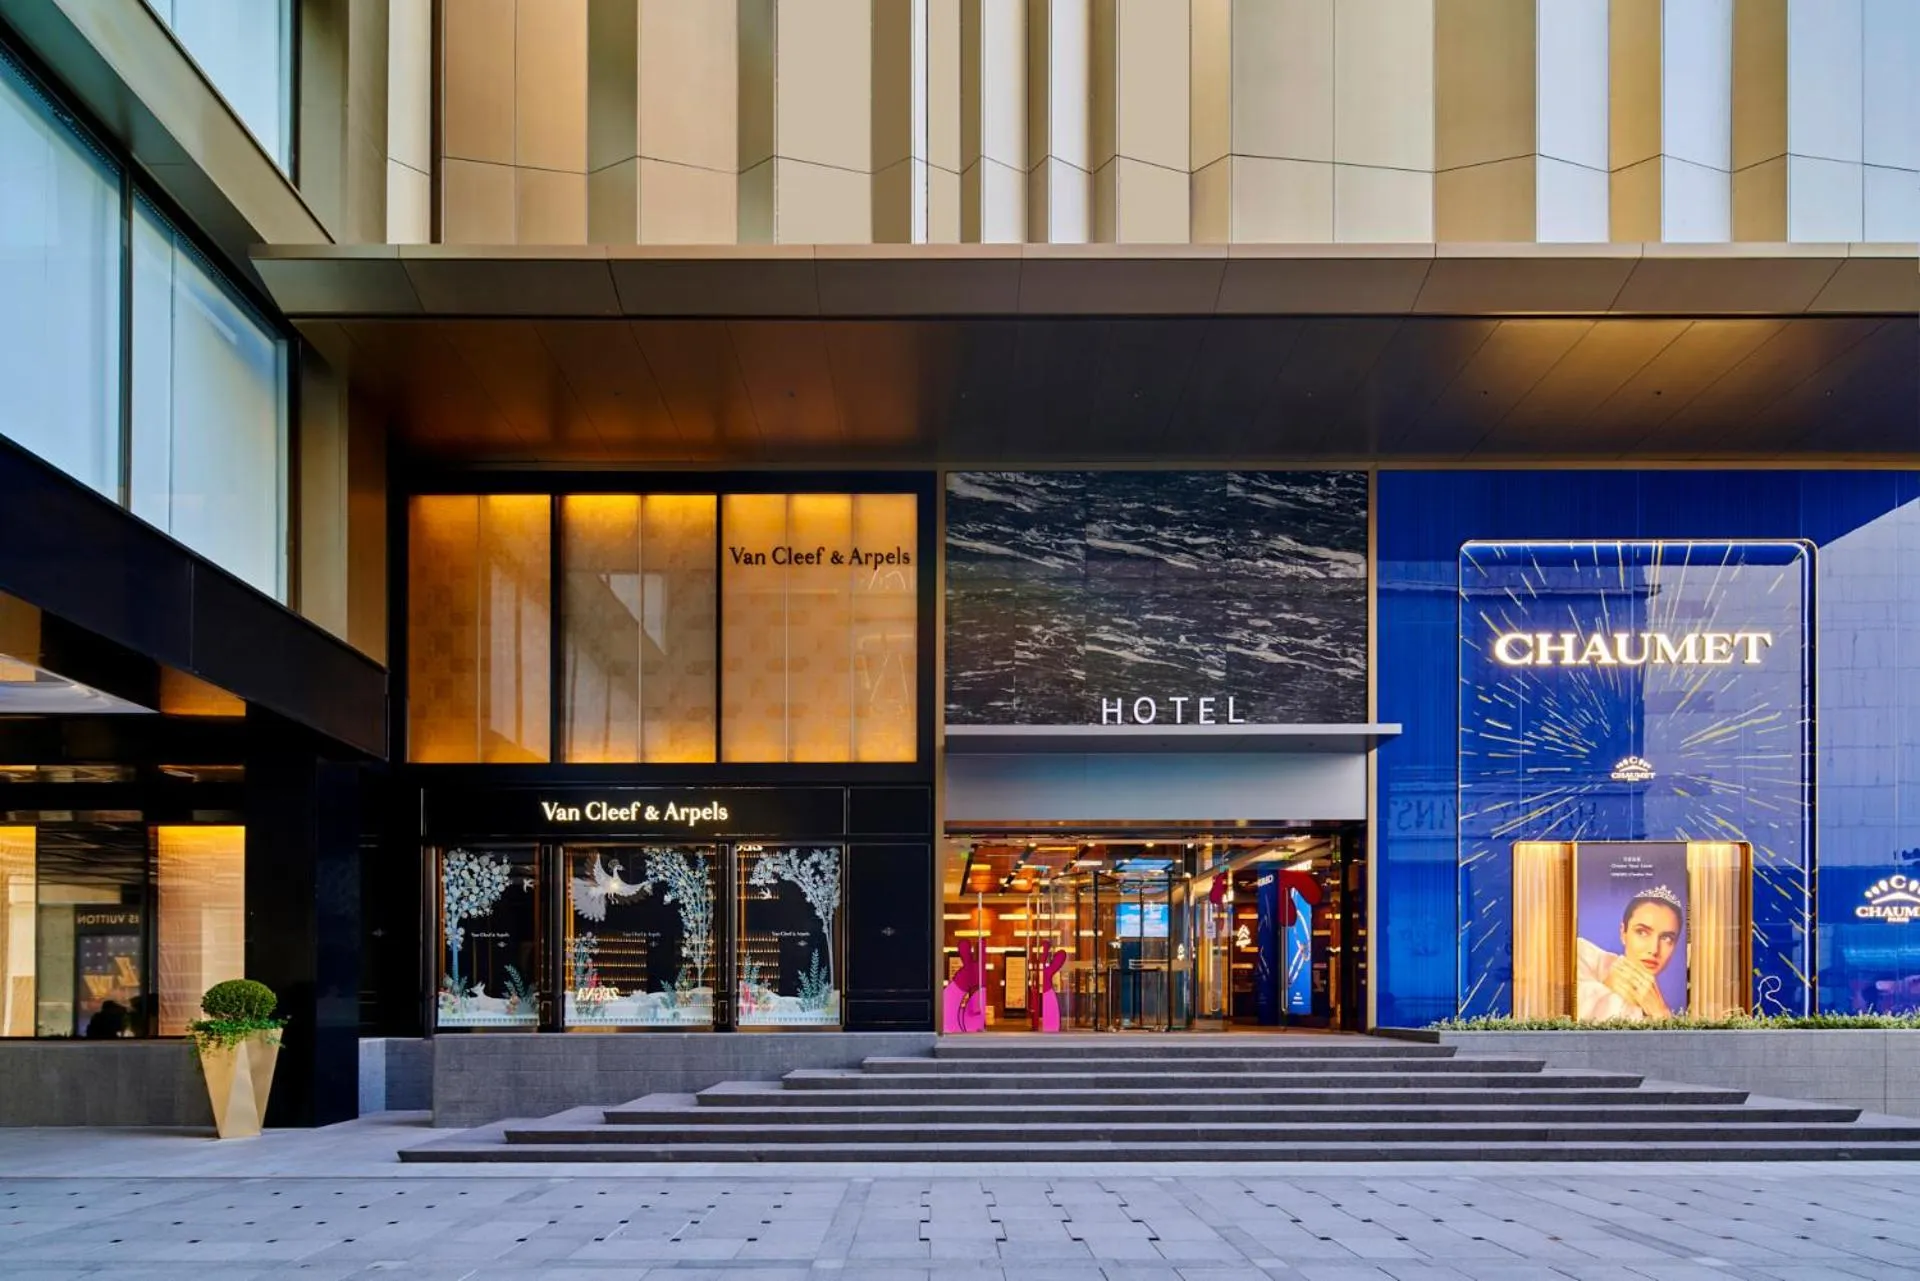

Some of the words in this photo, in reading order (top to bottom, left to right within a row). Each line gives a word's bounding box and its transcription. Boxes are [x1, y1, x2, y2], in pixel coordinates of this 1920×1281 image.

[729, 547, 766, 565] Van
[772, 546, 825, 565] Cleef
[830, 550, 844, 565] &
[848, 546, 911, 570] Arpels
[1494, 632, 1773, 665] CHAUMET
[1102, 696, 1245, 725] HOTEL
[541, 802, 580, 821] Van
[585, 801, 641, 821] Cleef
[645, 806, 660, 821] &
[664, 801, 729, 827] Arpels
